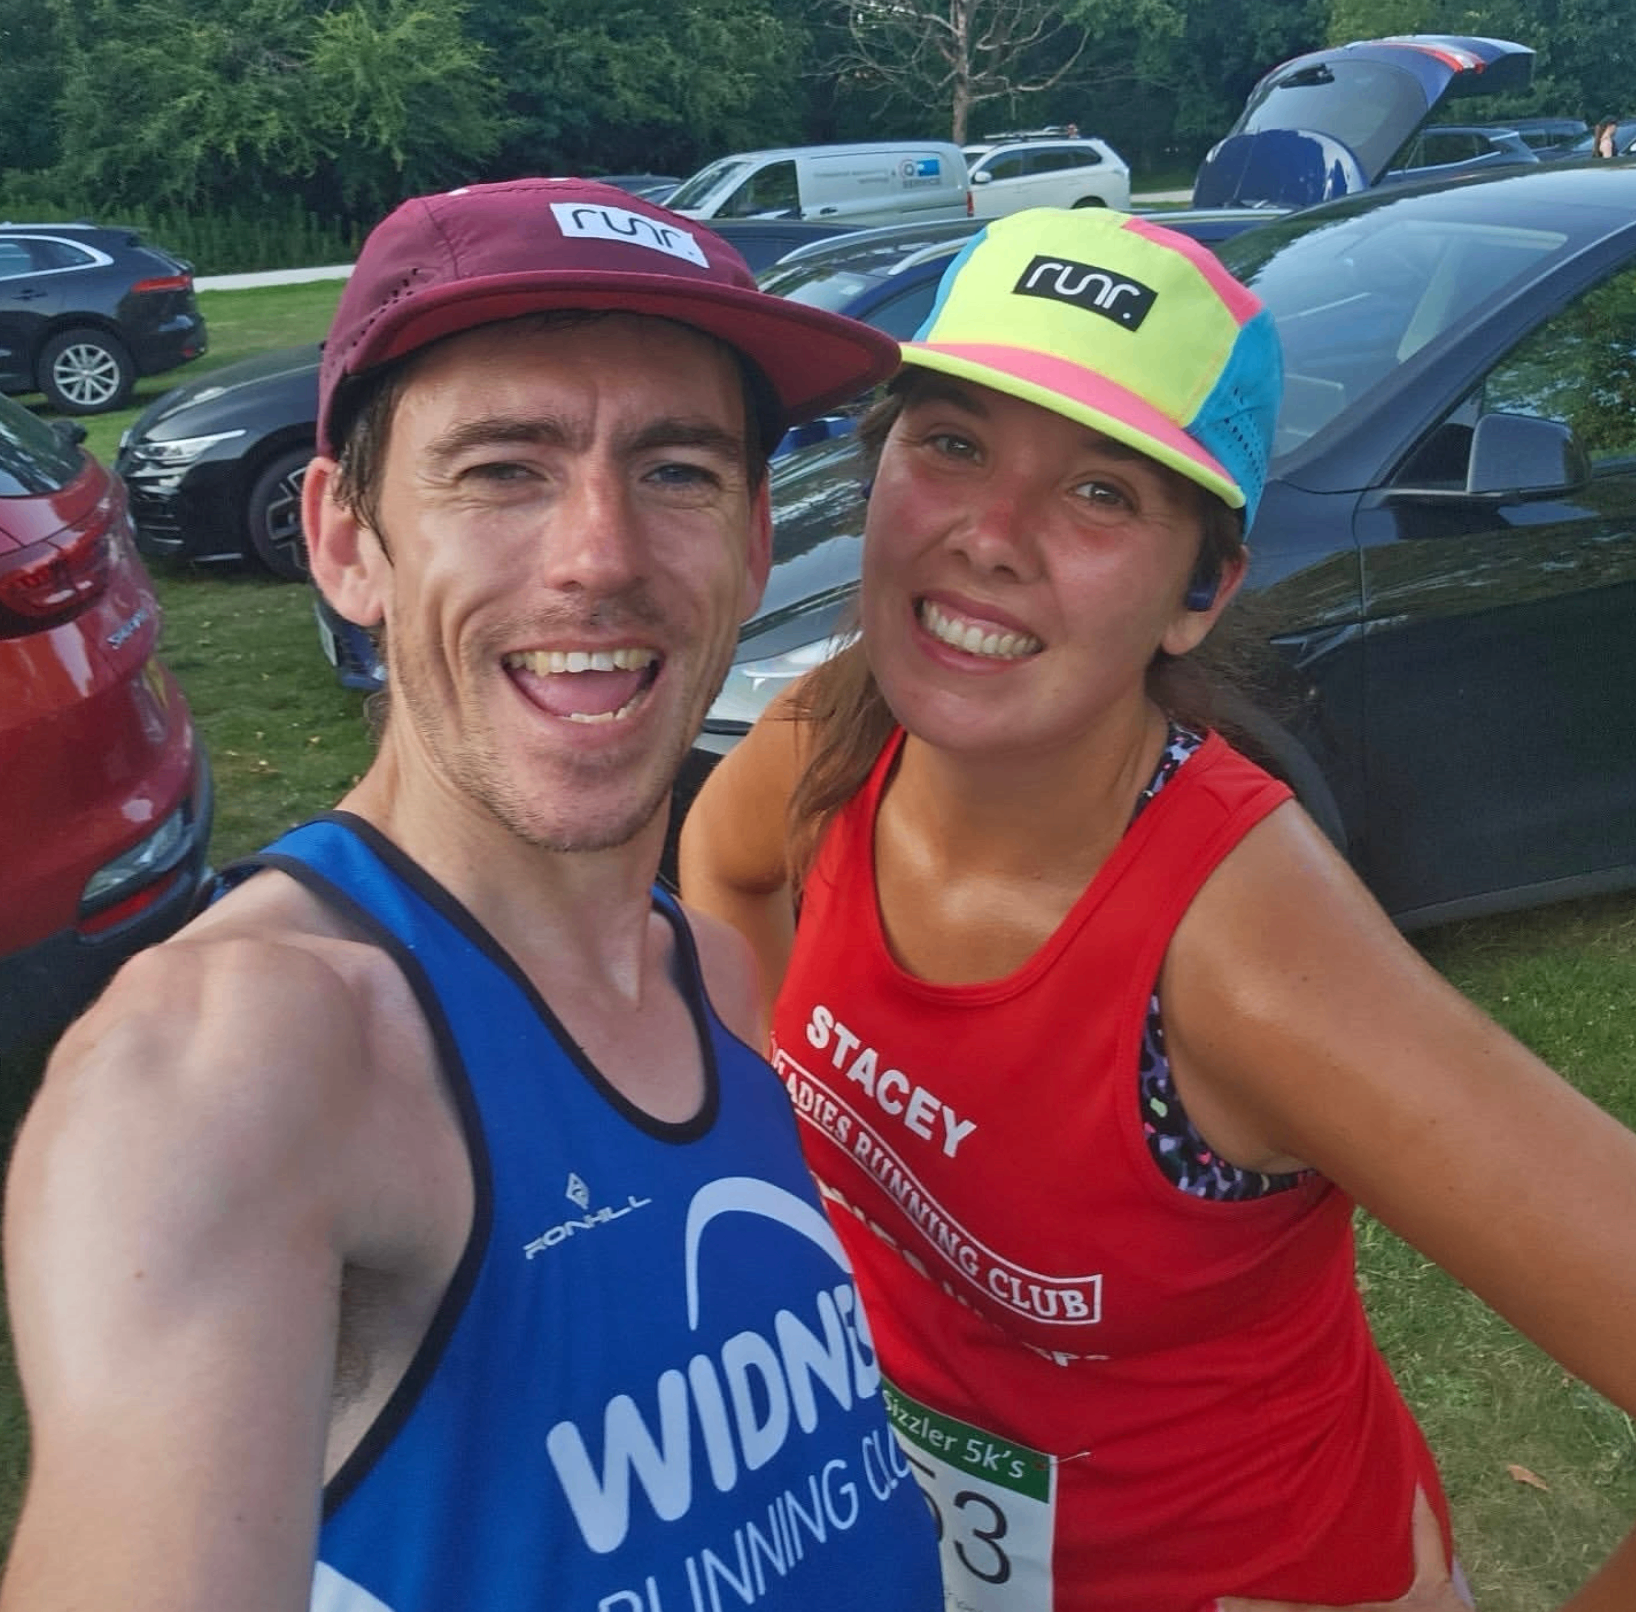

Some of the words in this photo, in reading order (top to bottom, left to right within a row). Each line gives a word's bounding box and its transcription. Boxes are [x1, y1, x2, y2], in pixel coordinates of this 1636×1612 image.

[806, 1005, 977, 1158] STACEY
[522, 1195, 652, 1260] RONHILL
[854, 1131, 980, 1277] RUNNING
[988, 1267, 1089, 1319] CLUB
[881, 1389, 959, 1451] Sizzler
